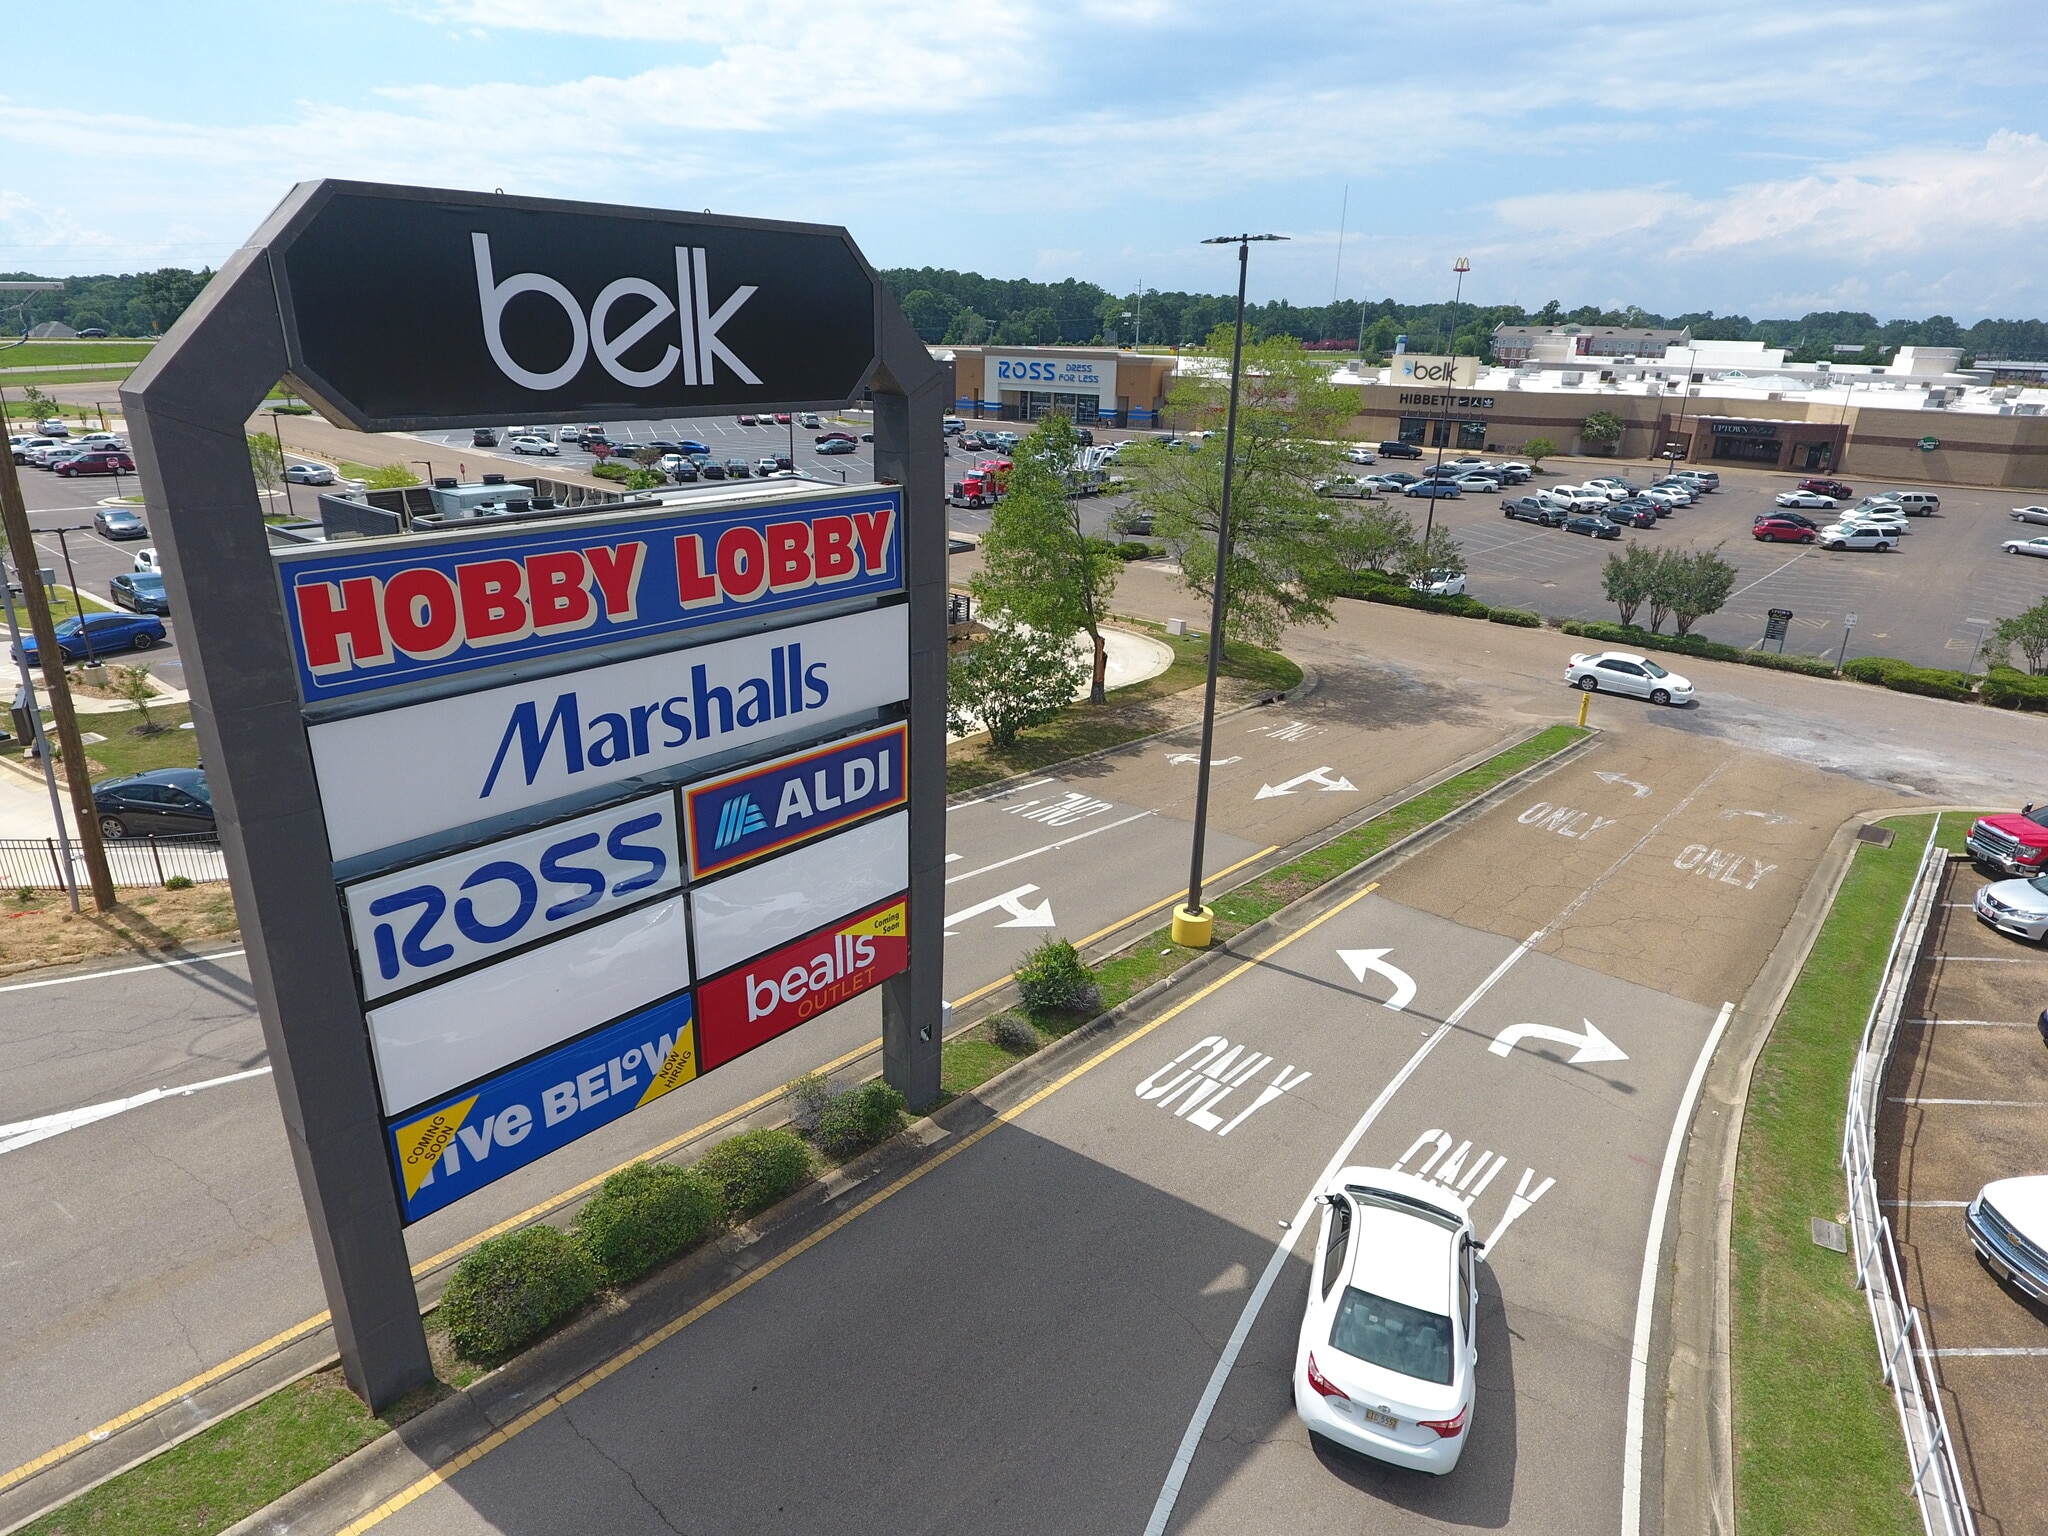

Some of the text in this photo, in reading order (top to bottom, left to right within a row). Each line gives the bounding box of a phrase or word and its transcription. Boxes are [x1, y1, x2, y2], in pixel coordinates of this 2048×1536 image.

[471, 232, 764, 390] belk
[999, 361, 1055, 380] ROSS
[1059, 373, 1099, 383] FOR LESS
[1066, 363, 1092, 373] DRESS
[1414, 361, 1458, 381] belk
[1400, 393, 1456, 407] HIBBETT
[1713, 424, 1748, 433] UPTOWN
[296, 509, 896, 675] HOBBY LOBBY
[479, 643, 829, 798] Marshalls
[775, 748, 890, 828] ALDI
[1001, 791, 1113, 826] ONLY
[1517, 802, 1616, 840] ONLY
[1673, 844, 1778, 890] ONLY
[369, 812, 667, 980] ROSS
[874, 912, 899, 929] Coming
[883, 922, 899, 935] Soon
[746, 935, 876, 1022] bealls
[798, 966, 876, 1018] OUTLET
[659, 1051, 680, 1079] NOW
[664, 1050, 692, 1089] HIRING
[1135, 1036, 1313, 1138] ONLY
[407, 1115, 445, 1165] COMING
[424, 1125, 454, 1161] SOON
